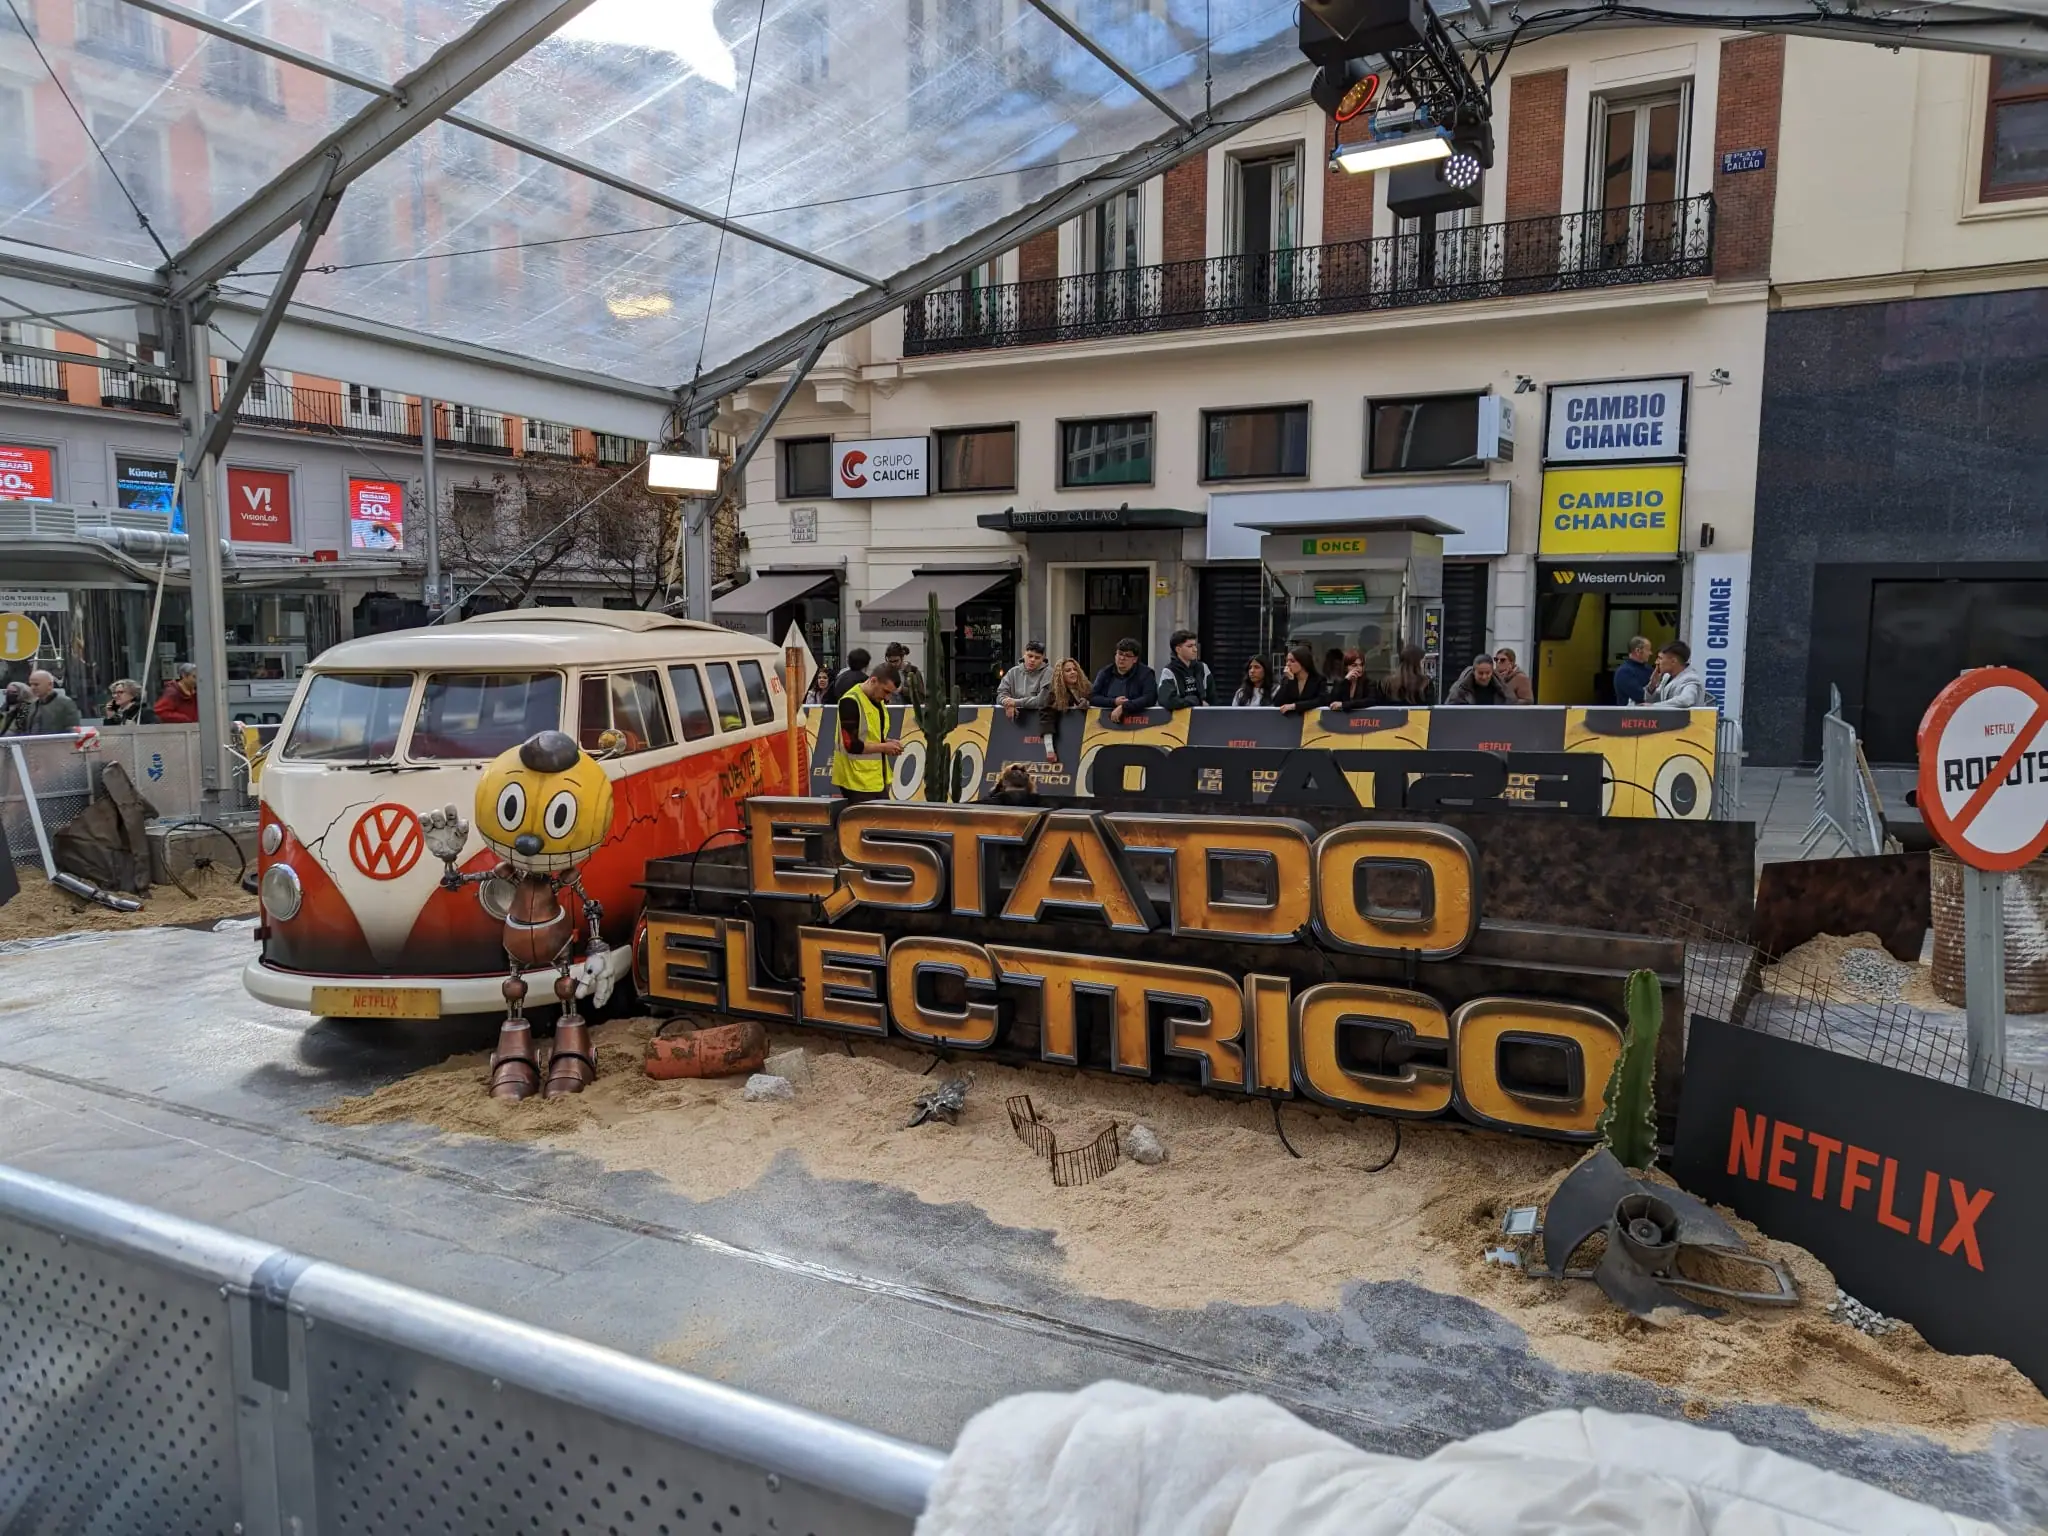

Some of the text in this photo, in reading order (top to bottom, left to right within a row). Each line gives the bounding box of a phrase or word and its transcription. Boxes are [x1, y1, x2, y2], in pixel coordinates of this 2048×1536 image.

[1734, 150, 1763, 159] PLAZA
[1727, 160, 1760, 171] CALLAO
[1567, 393, 1666, 422] CAMBIO
[1565, 421, 1664, 450] CHANGE
[873, 454, 913, 467] GRUPO
[873, 468, 920, 482] CALICHE
[1558, 490, 1664, 510] CAMBIO
[1013, 511, 1119, 524] EDIFICIO CALLAO
[1554, 512, 1666, 531] CHANGE
[1321, 540, 1360, 552] ONCE
[1577, 571, 1628, 583] Western
[1629, 571, 1666, 583] Union
[1707, 577, 1732, 649] CHANGE
[881, 617, 927, 628] Restaurant
[1124, 716, 1149, 725] NETFLIX
[1350, 718, 1381, 728] NETFLIX
[1621, 718, 1658, 729] NETFLIX
[1984, 722, 2016, 738] NETFLIX
[1228, 740, 1257, 748] NETFLIX
[1478, 742, 1512, 751] NETFLIX
[746, 796, 1482, 963] ESTADO
[353, 994, 398, 1009] NETFLIX
[1727, 1107, 1995, 1272] NETFLIX
